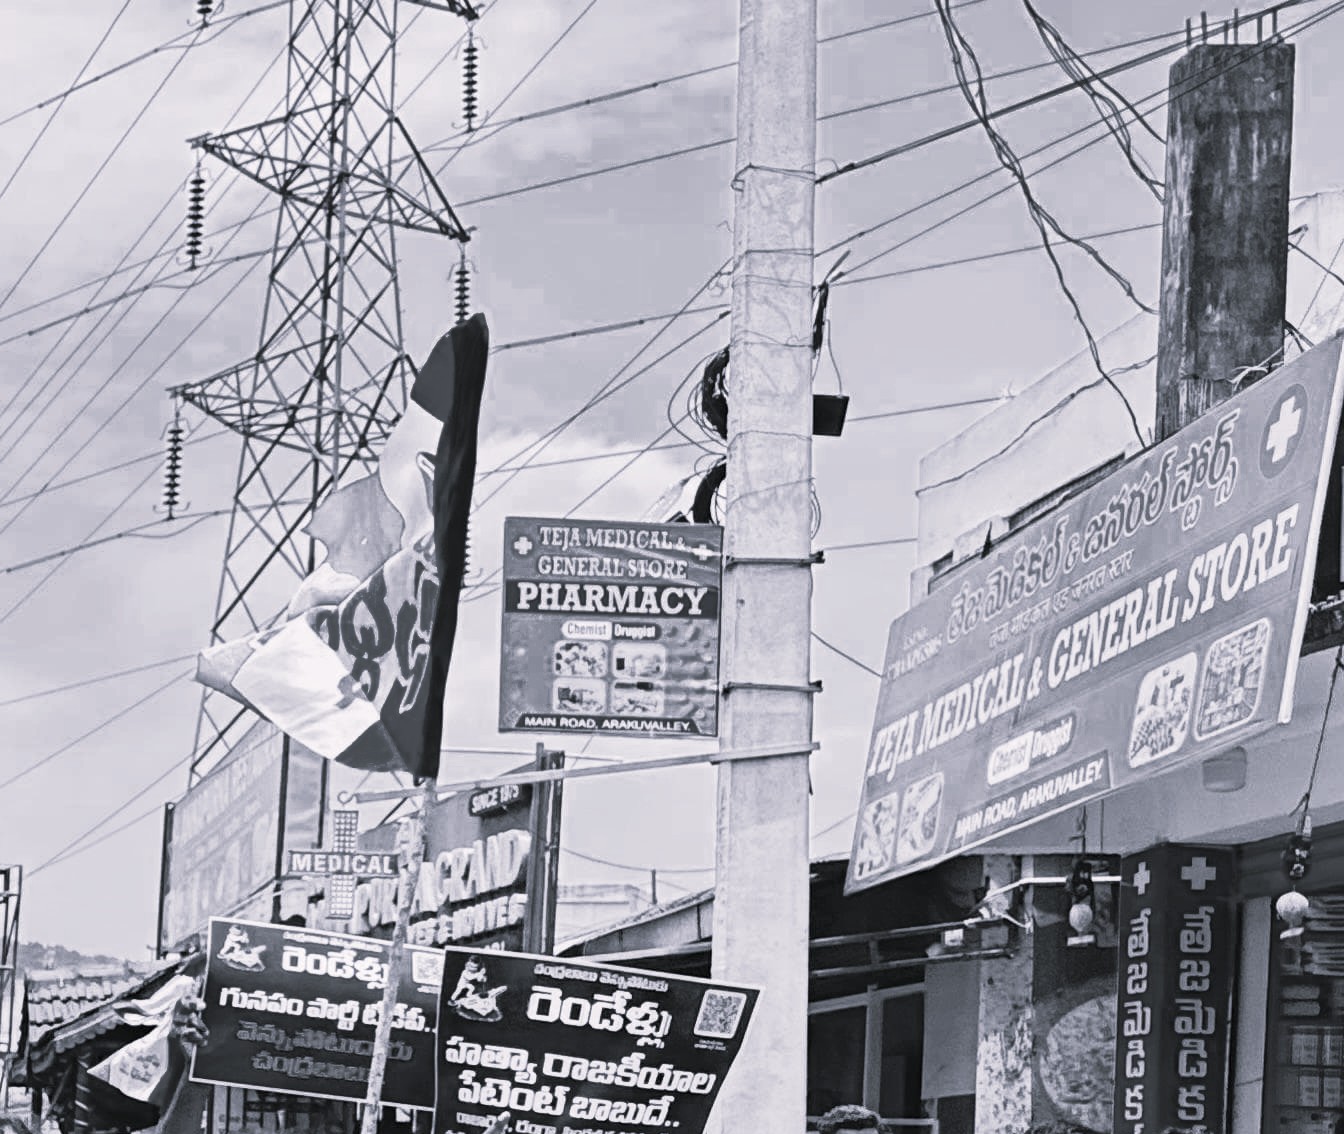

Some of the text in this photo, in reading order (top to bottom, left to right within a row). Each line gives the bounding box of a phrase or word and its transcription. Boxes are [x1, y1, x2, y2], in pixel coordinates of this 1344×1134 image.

[539, 527, 580, 551] TEJA
[585, 528, 671, 550] MEDICAL
[538, 555, 688, 579] GENERAL STORE
[517, 582, 708, 615] PHARMACY
[567, 623, 656, 639] Chemist Druggist
[867, 710, 920, 782] TEJA
[915, 653, 1025, 755] MEDICAL
[1026, 656, 1043, 700] &
[1047, 590, 1179, 688] GENERAL
[1181, 503, 1298, 622] STORE
[524, 717, 556, 728] MAIN
[955, 814, 982, 839] MAIN
[292, 854, 393, 874] MEDICAL
[534, 963, 598, 983] చంద్రబాబు
[219, 987, 304, 1016] గునపం
[306, 997, 360, 1031] పార్టీ
[527, 985, 673, 1048] రెండేళ్లు
[445, 1036, 717, 1095] హత్యా రాజకీయాల
[458, 1070, 680, 1128] పేటెంట్ బాబుదే..
